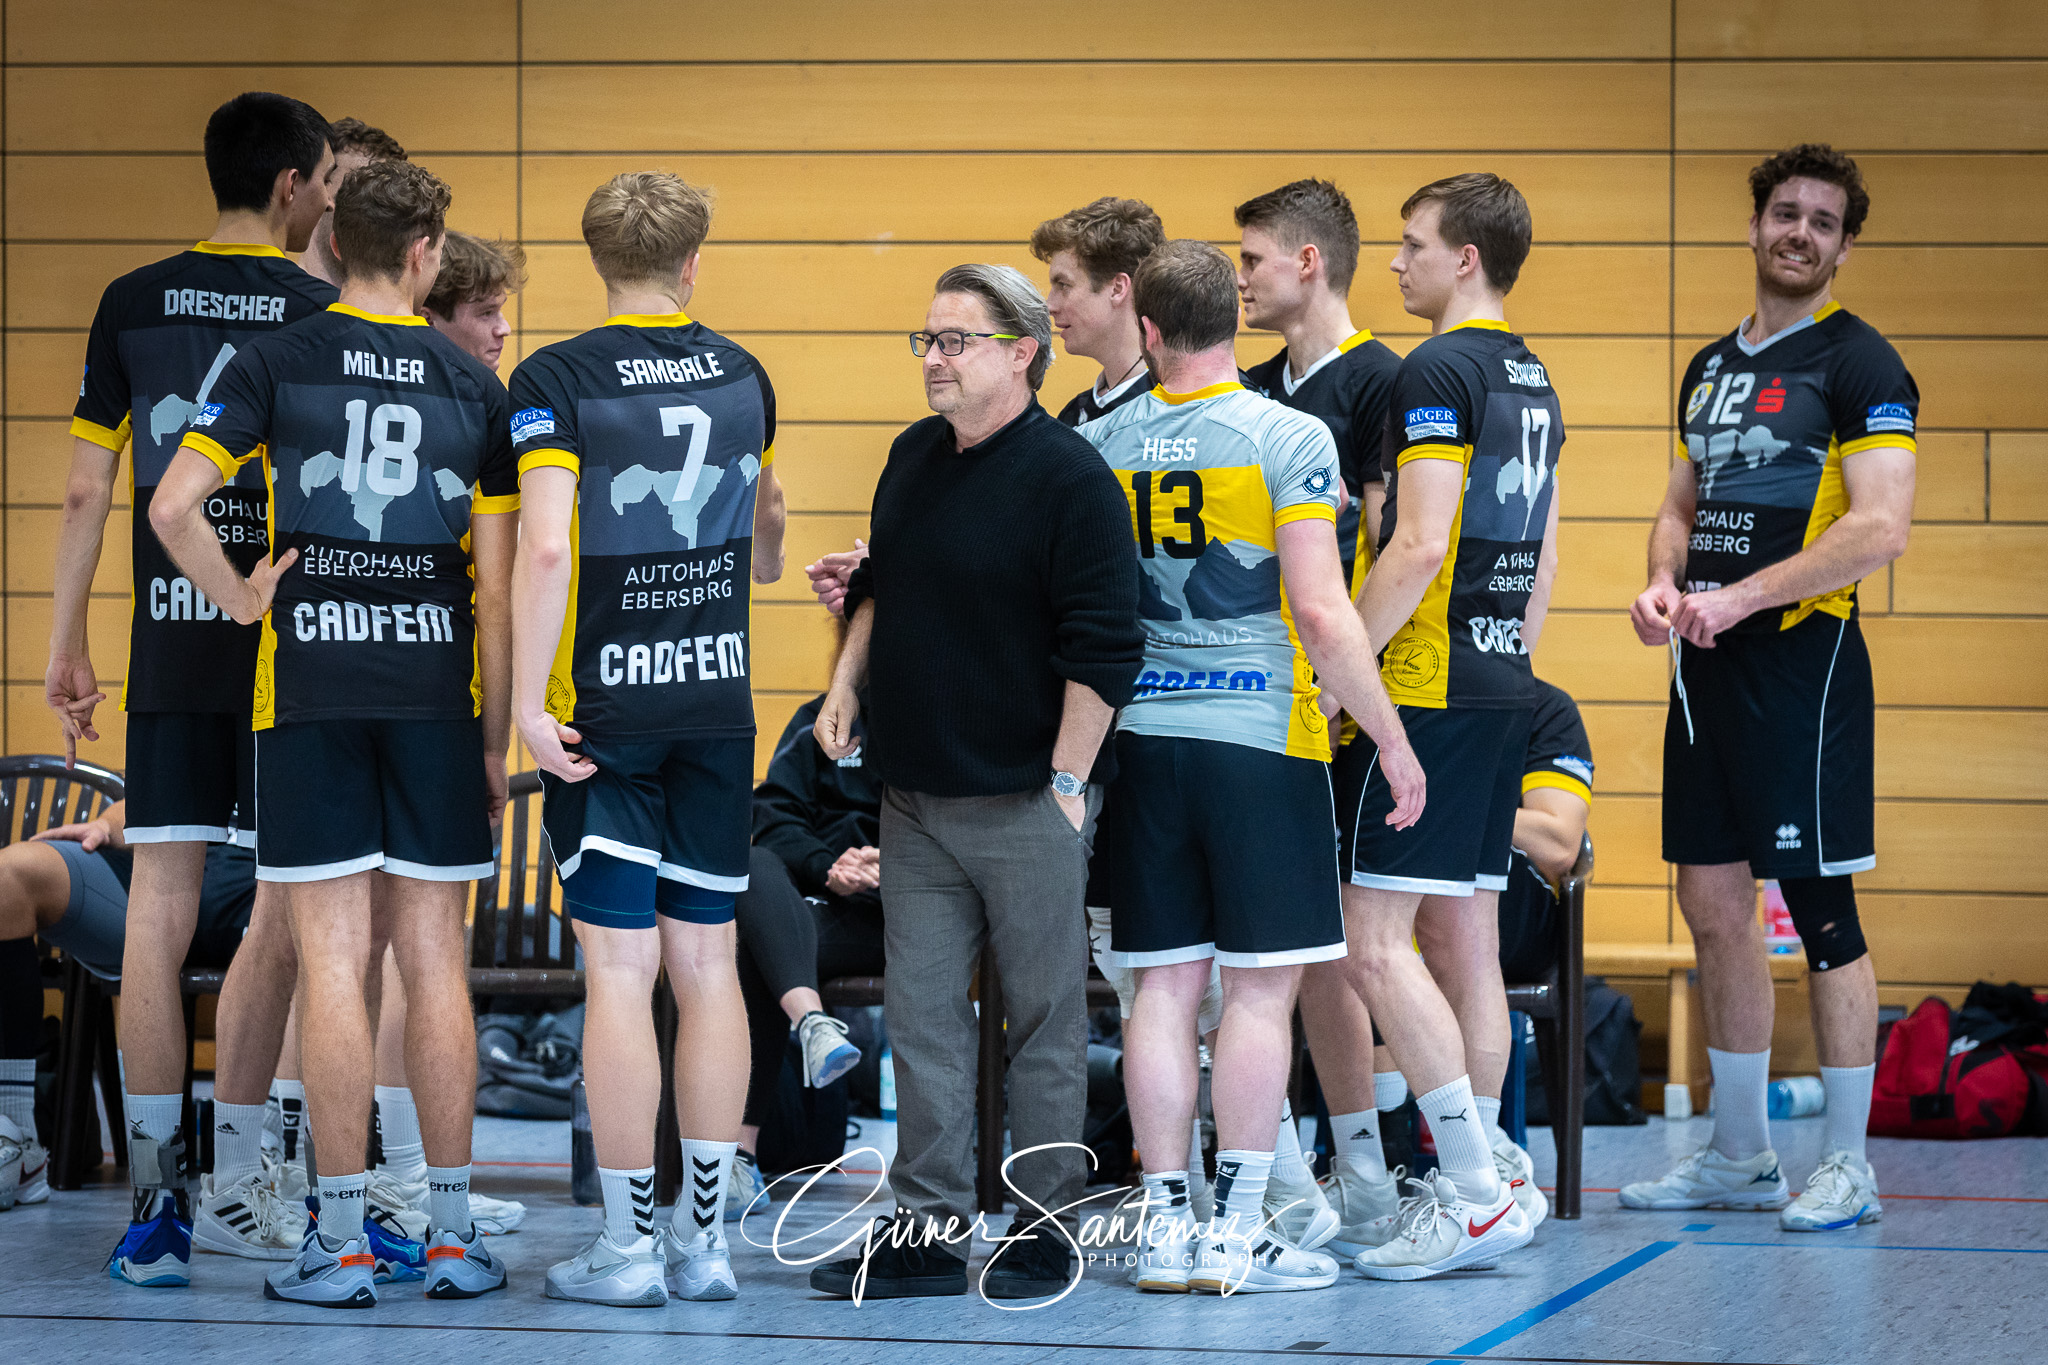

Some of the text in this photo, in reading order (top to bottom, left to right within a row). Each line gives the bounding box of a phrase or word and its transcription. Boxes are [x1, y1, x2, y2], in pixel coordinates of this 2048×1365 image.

[165, 288, 286, 322] DRESCHER
[615, 352, 725, 386] SAMBALE
[1708, 372, 1755, 424] 12
[1409, 409, 1453, 423] RÜGER
[345, 399, 421, 496] 18
[659, 404, 712, 502] 7
[1142, 437, 1198, 462] HESS
[1522, 407, 1551, 496] 17
[1131, 470, 1206, 559] 13
[624, 552, 735, 586] AUTOHAUS
[622, 579, 732, 610] EBERSBRG
